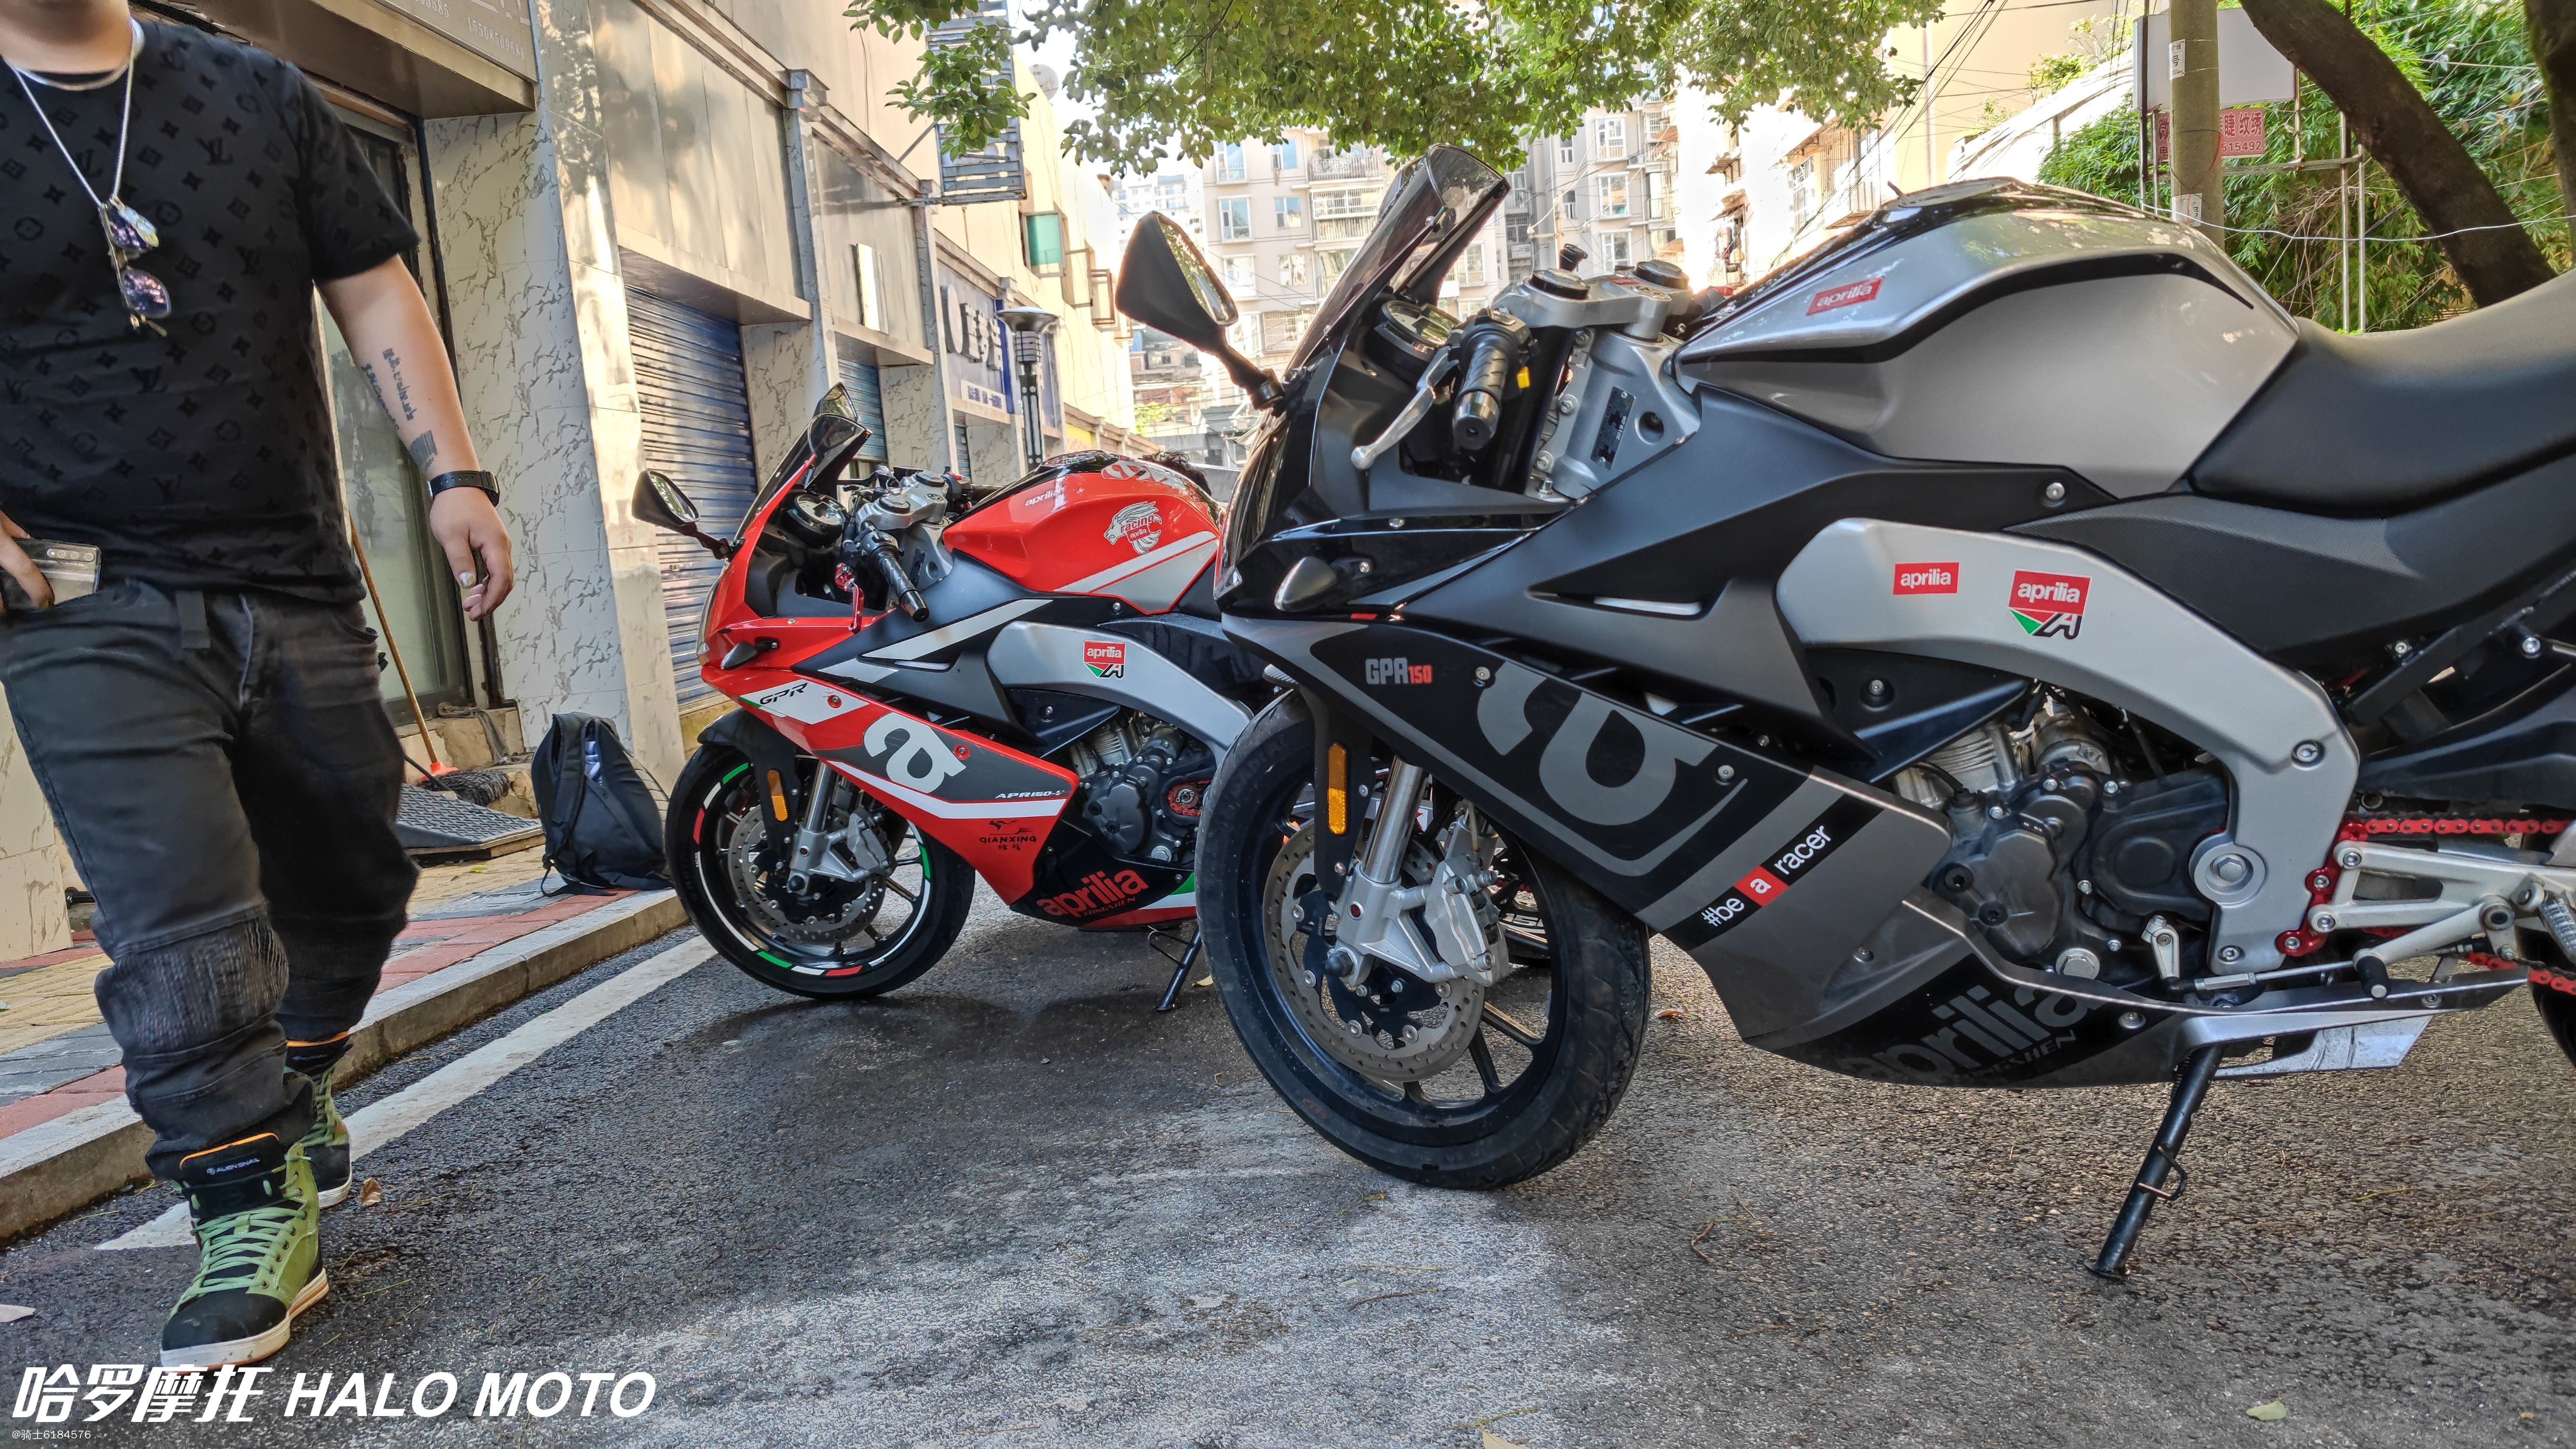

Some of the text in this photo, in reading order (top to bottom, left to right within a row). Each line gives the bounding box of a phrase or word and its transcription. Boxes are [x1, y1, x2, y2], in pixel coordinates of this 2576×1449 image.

[1816, 283, 1873, 307] aprilia
[1024, 486, 1066, 507] aprilia
[1121, 515, 1154, 533] racing
[1130, 528, 1147, 538] aprilia
[1900, 568, 1951, 589] aprilia
[2017, 582, 2081, 603] aprilia
[1087, 646, 1122, 659] aprilia
[760, 683, 808, 704] GPR
[1701, 825, 1831, 927] #be a racer
[1036, 870, 1149, 918] aprilia
[1835, 985, 2108, 1079] aprilia
